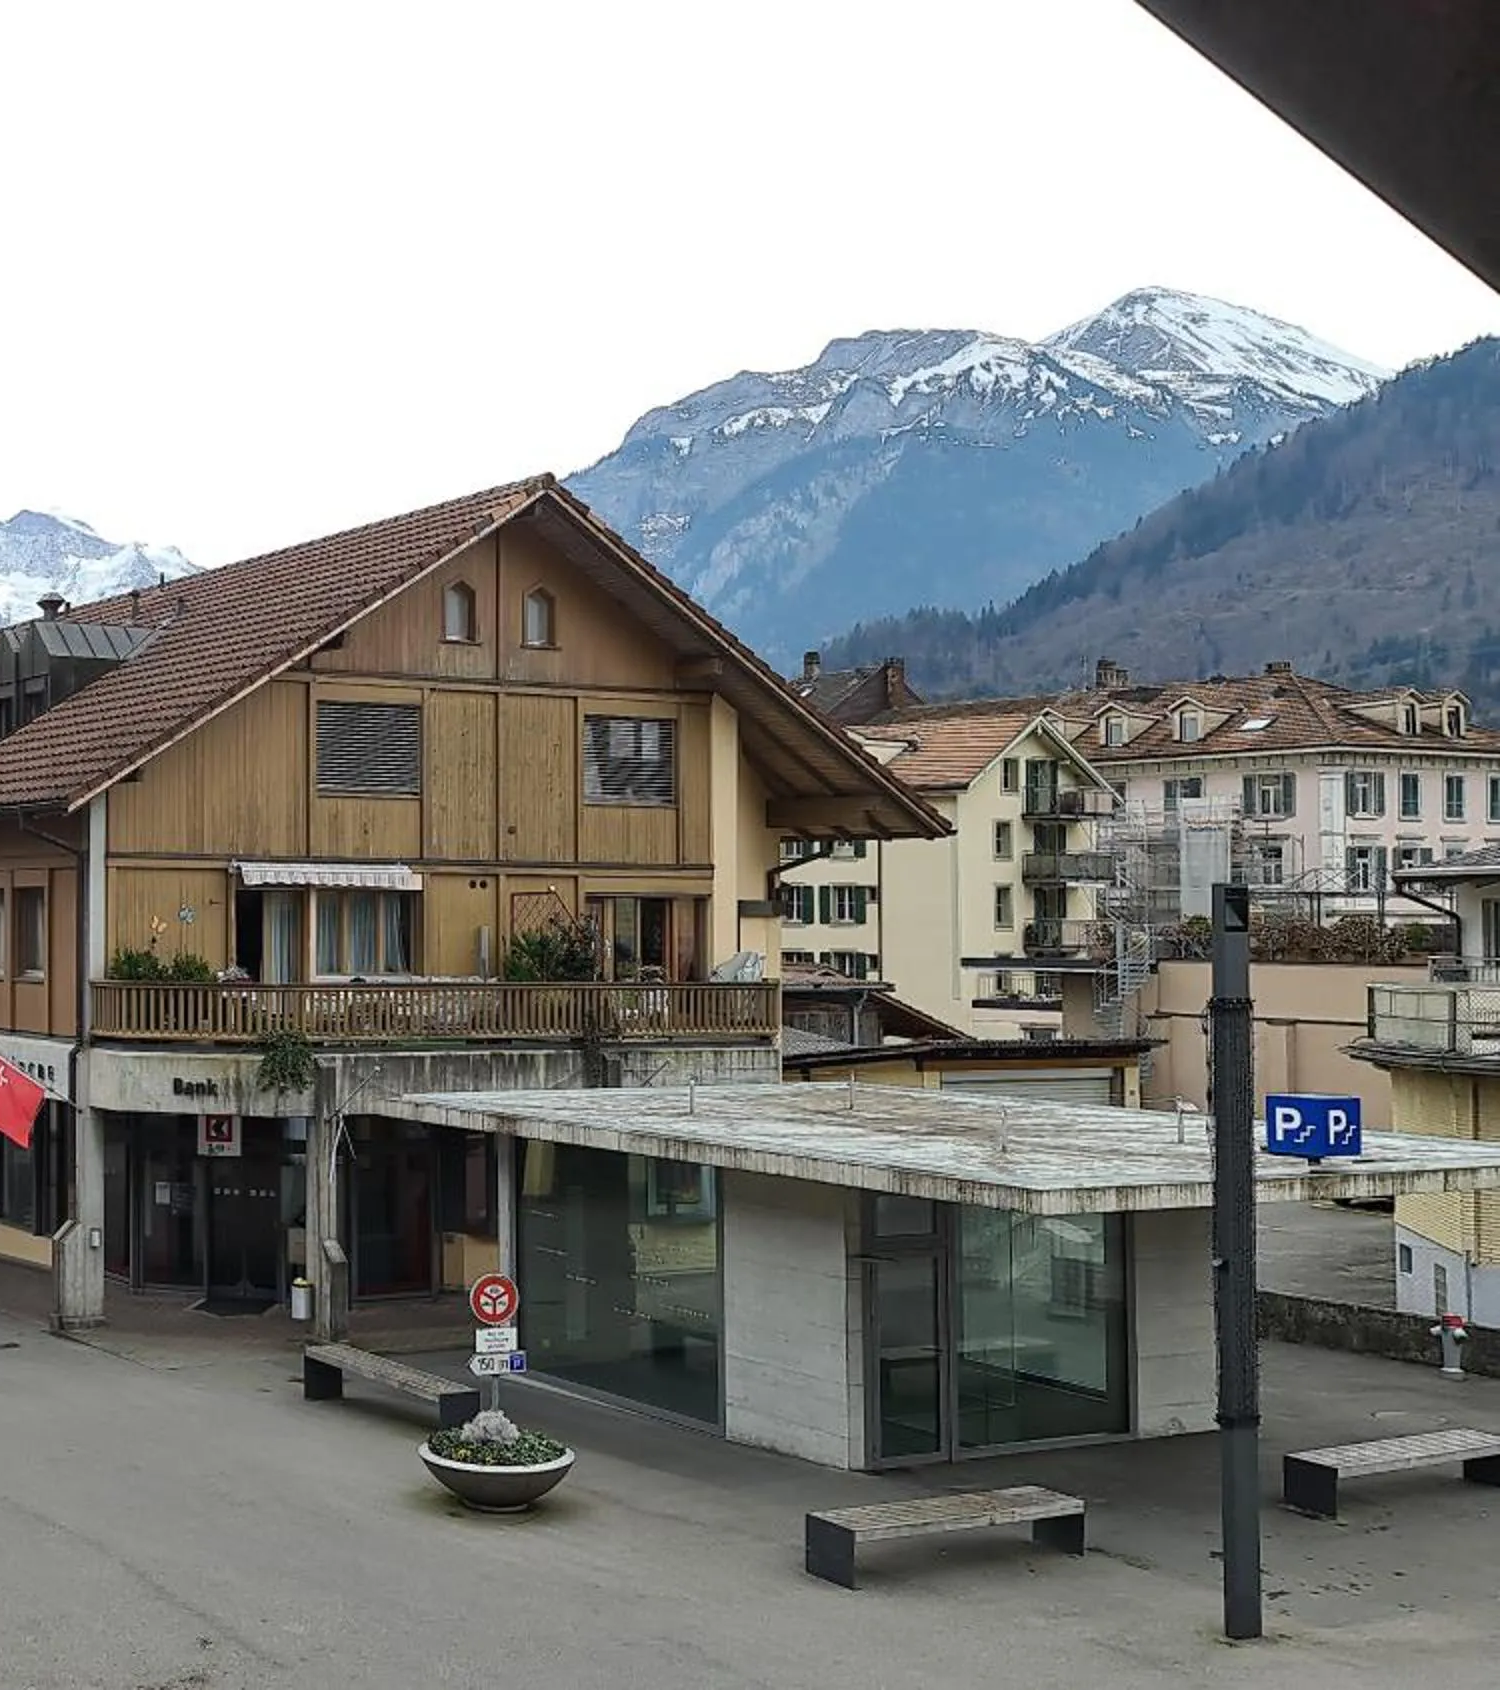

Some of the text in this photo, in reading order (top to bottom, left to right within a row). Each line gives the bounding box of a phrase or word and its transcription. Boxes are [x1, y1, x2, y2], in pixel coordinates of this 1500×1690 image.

[173, 1077, 219, 1097] Bank
[1275, 1106, 1302, 1141] P
[1328, 1108, 1347, 1145] P
